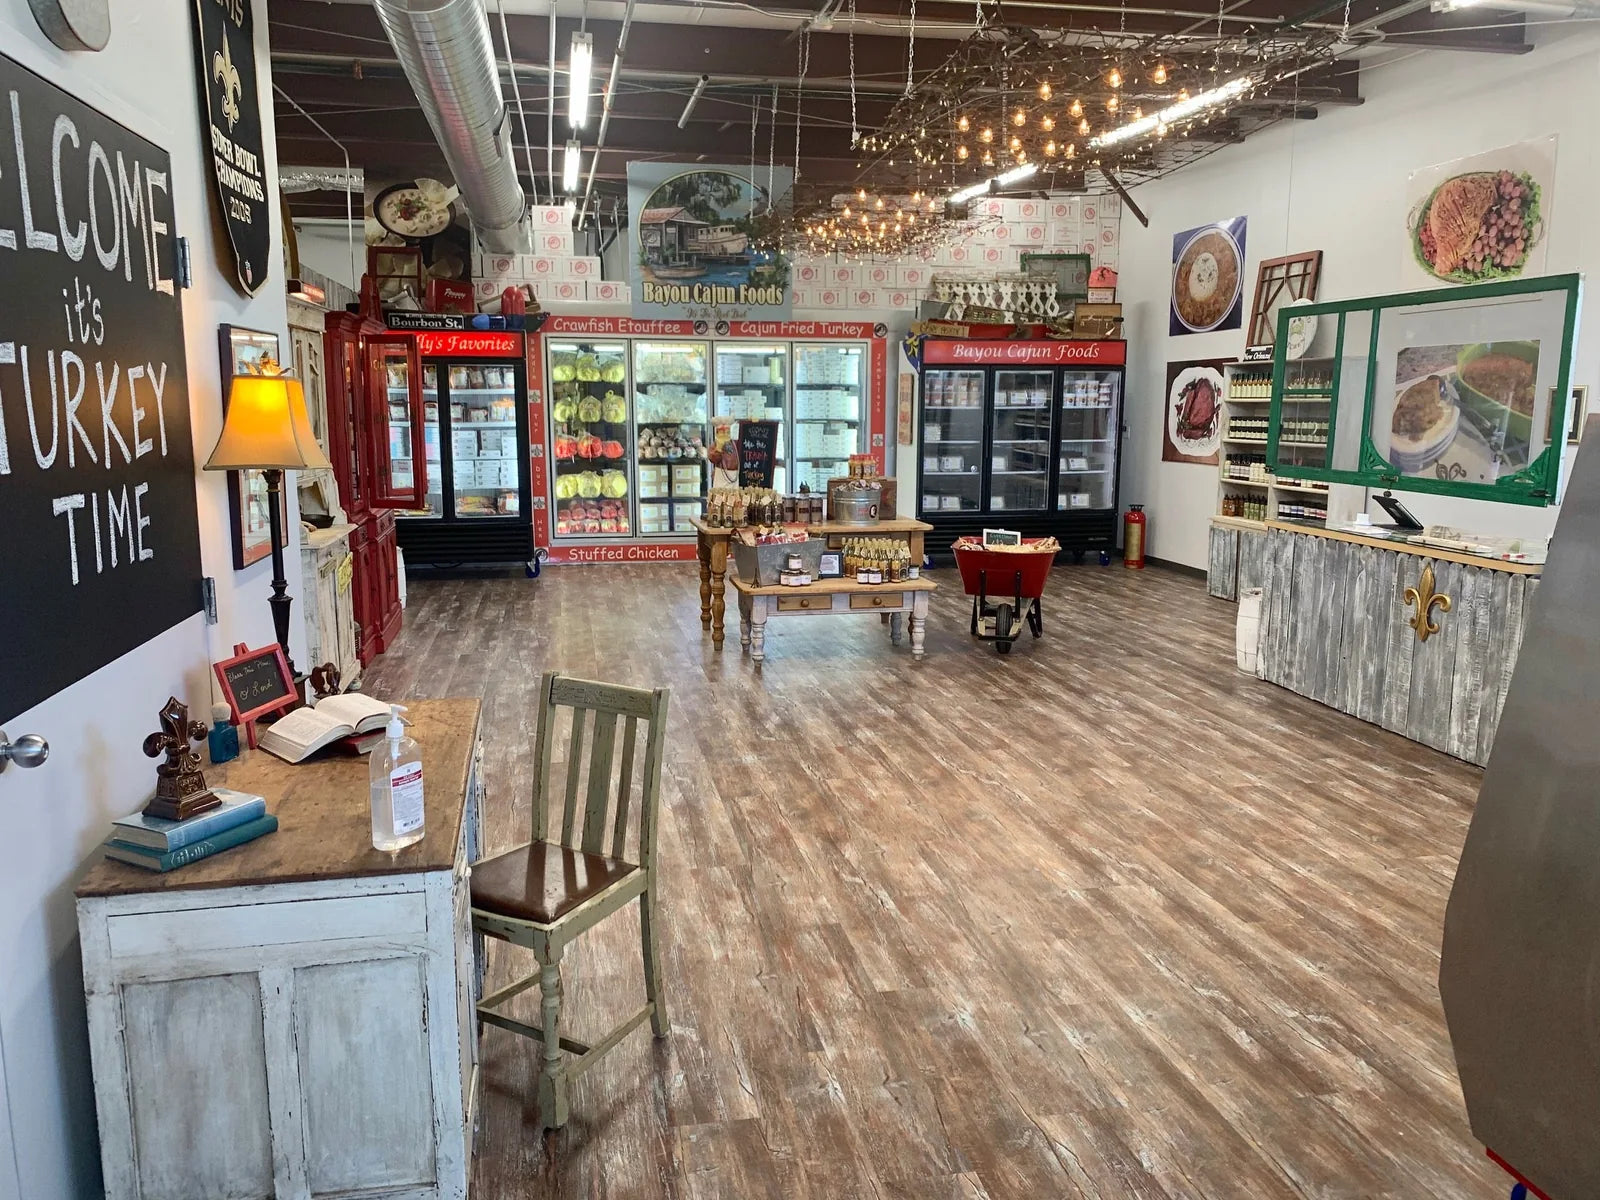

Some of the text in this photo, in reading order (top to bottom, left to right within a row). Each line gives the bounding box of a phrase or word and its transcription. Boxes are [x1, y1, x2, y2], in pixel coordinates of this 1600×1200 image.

[211, 123, 262, 177] SUPER BOWL
[214, 155, 265, 203] CHAMPIONS
[0, 90, 175, 296] LCOME
[643, 282, 784, 307] Bayou Cajun Foods
[62, 276, 104, 345] it's
[391, 317, 463, 329] Bourbon St.
[553, 319, 681, 334] Crawfish Etouffee
[740, 322, 864, 338] Cajun Fried Turkey
[448, 335, 515, 351] Favorites
[953, 343, 1100, 363] Bayou Cajun Foods
[52, 482, 153, 585] TIME
[568, 547, 679, 561] Stuffed Chicken
